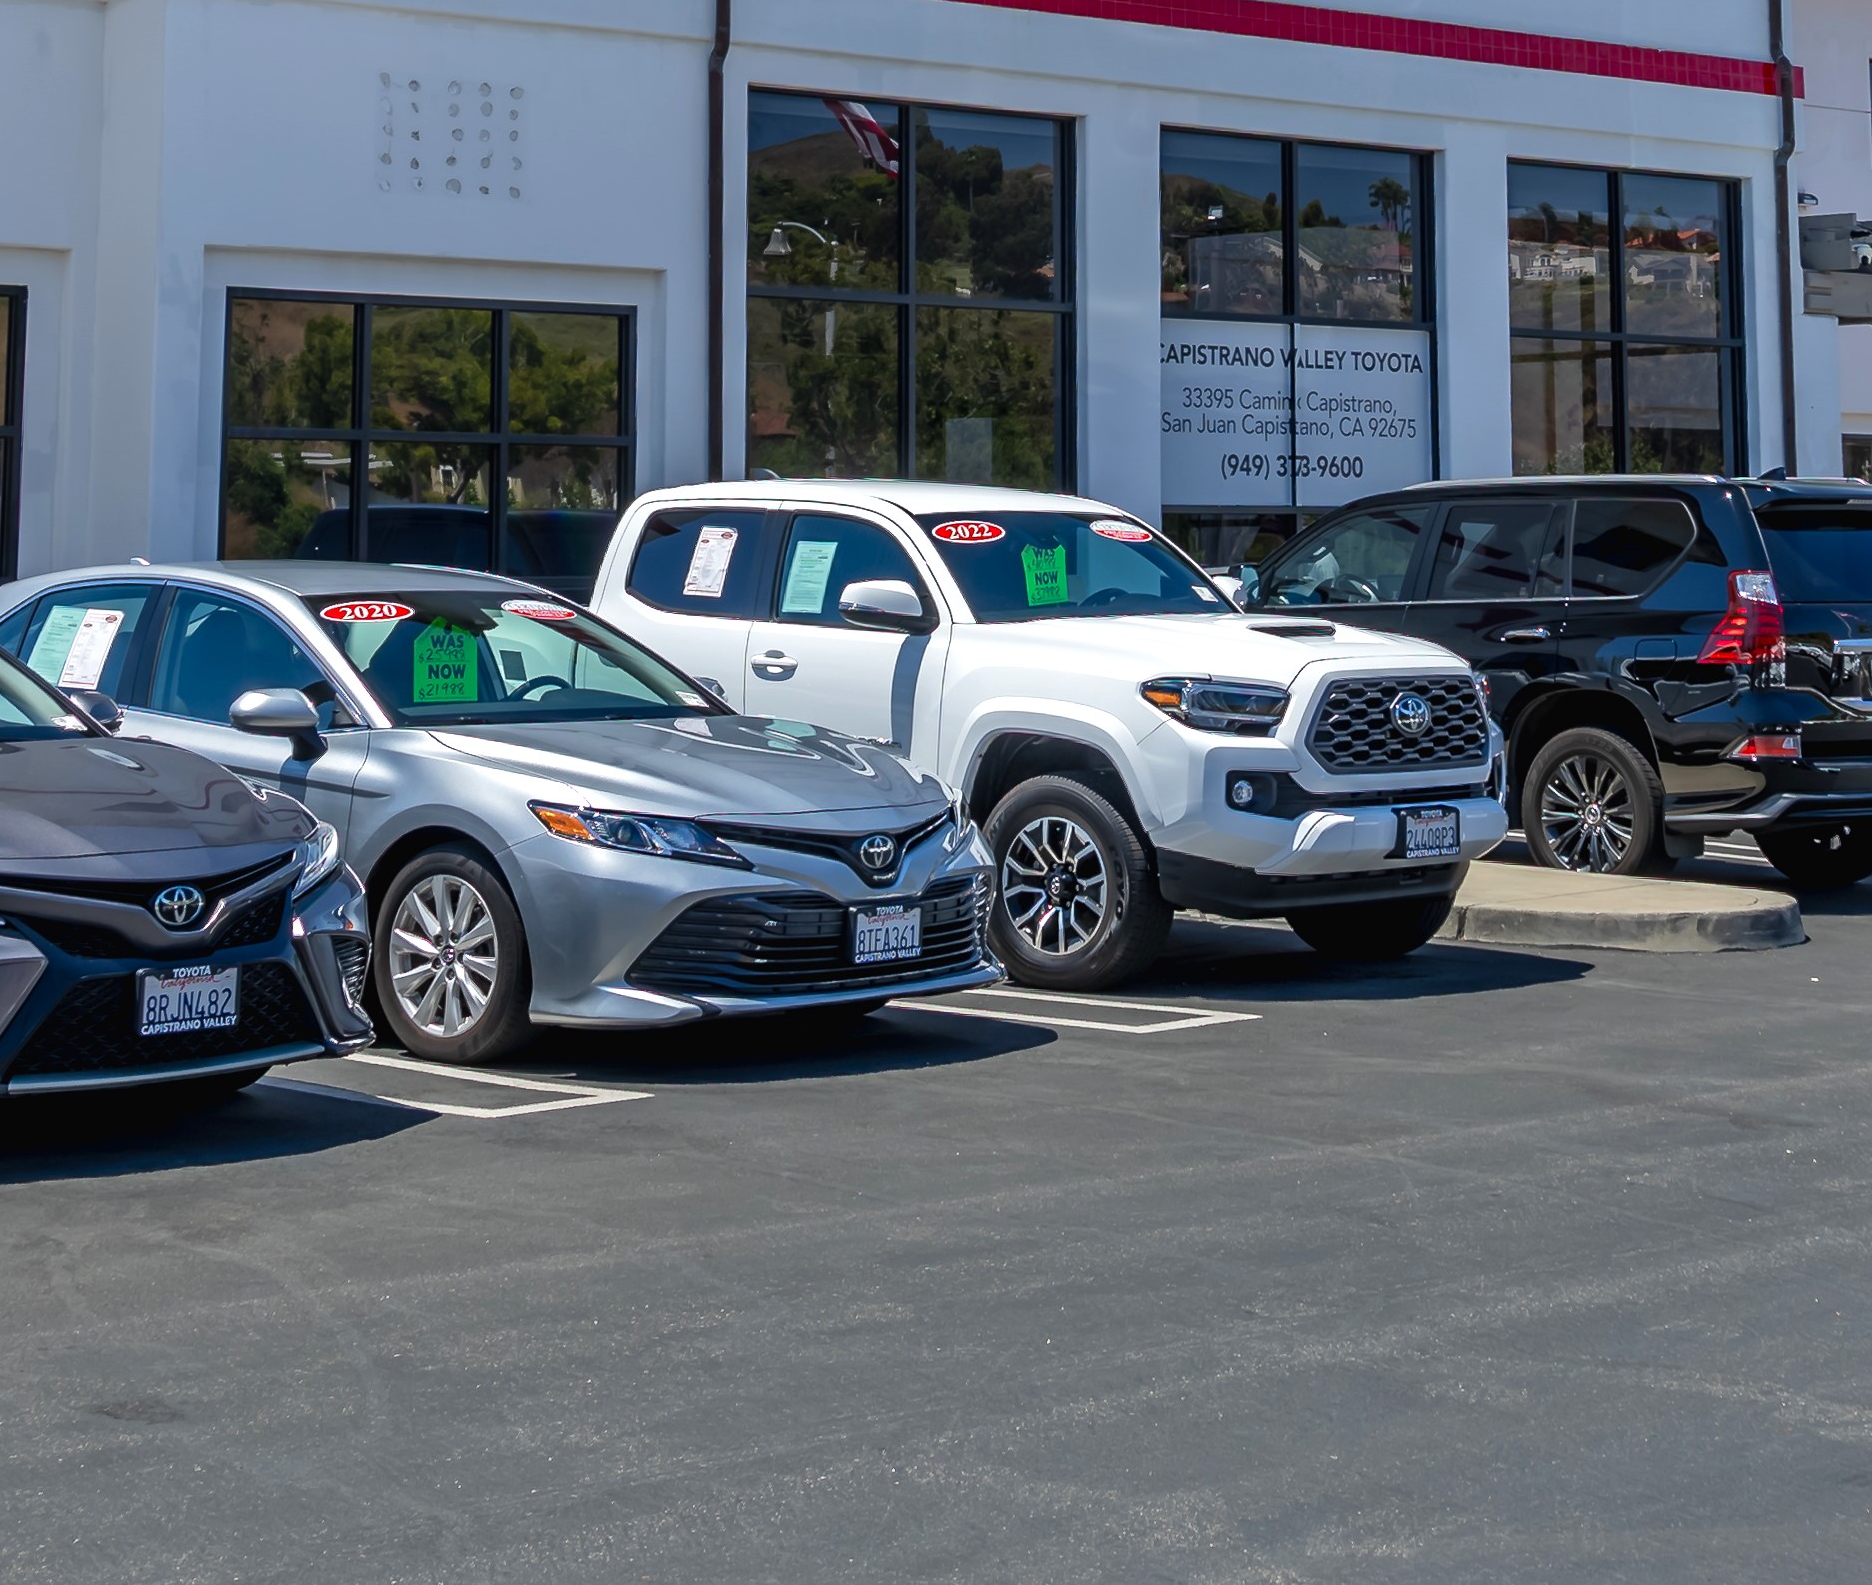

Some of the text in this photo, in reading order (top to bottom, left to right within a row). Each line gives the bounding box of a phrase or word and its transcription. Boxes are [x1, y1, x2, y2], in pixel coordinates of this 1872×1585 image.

[1160, 343, 1274, 368] APISTRANO
[1351, 351, 1423, 374] TOYOTA
[1182, 387, 1234, 409] 33395
[1306, 391, 1397, 419] Capistrano,
[1161, 411, 1192, 433] San
[1197, 414, 1236, 434] Juan
[1339, 417, 1364, 437] CA
[1368, 418, 1417, 439] 92675
[1221, 453, 1270, 481] (949)
[946, 523, 992, 539] 2022
[1034, 571, 1058, 585] NOW
[339, 605, 397, 620] 2020
[430, 635, 464, 648] WAS
[428, 664, 466, 679] NOW
[876, 905, 903, 915] TOYOTA
[855, 947, 921, 964] CAPISTRANO VALLEY
[173, 965, 211, 978] TOYOTA
[146, 987, 233, 1023] 8RJN482
[141, 1015, 237, 1035] CAPISTRANO VALLEY
